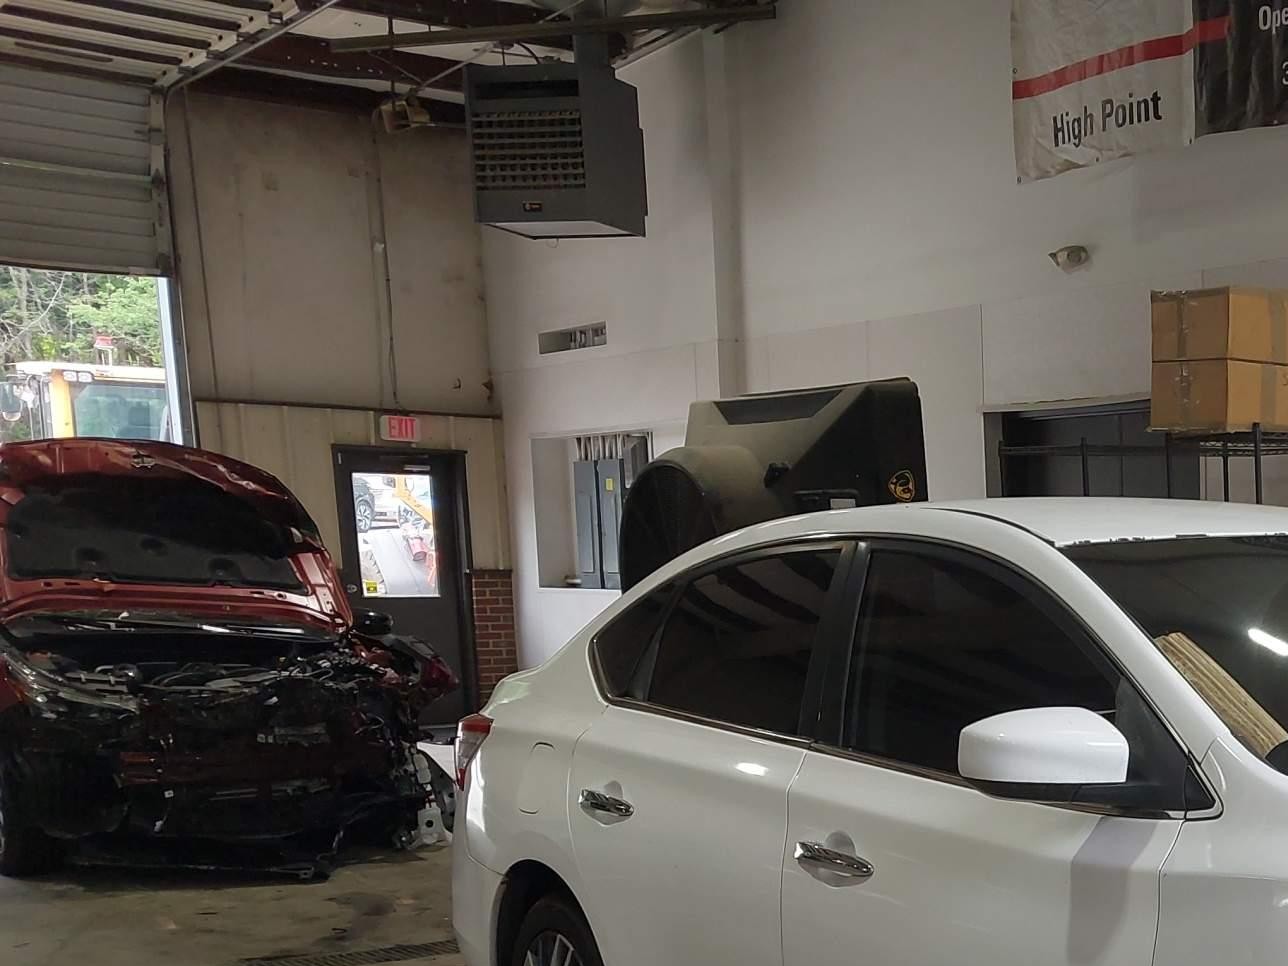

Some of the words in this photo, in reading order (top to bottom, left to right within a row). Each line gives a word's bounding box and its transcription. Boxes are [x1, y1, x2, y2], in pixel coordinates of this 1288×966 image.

[1053, 105, 1094, 147] High
[1101, 90, 1162, 132] Point
[388, 416, 417, 439] EXIT
